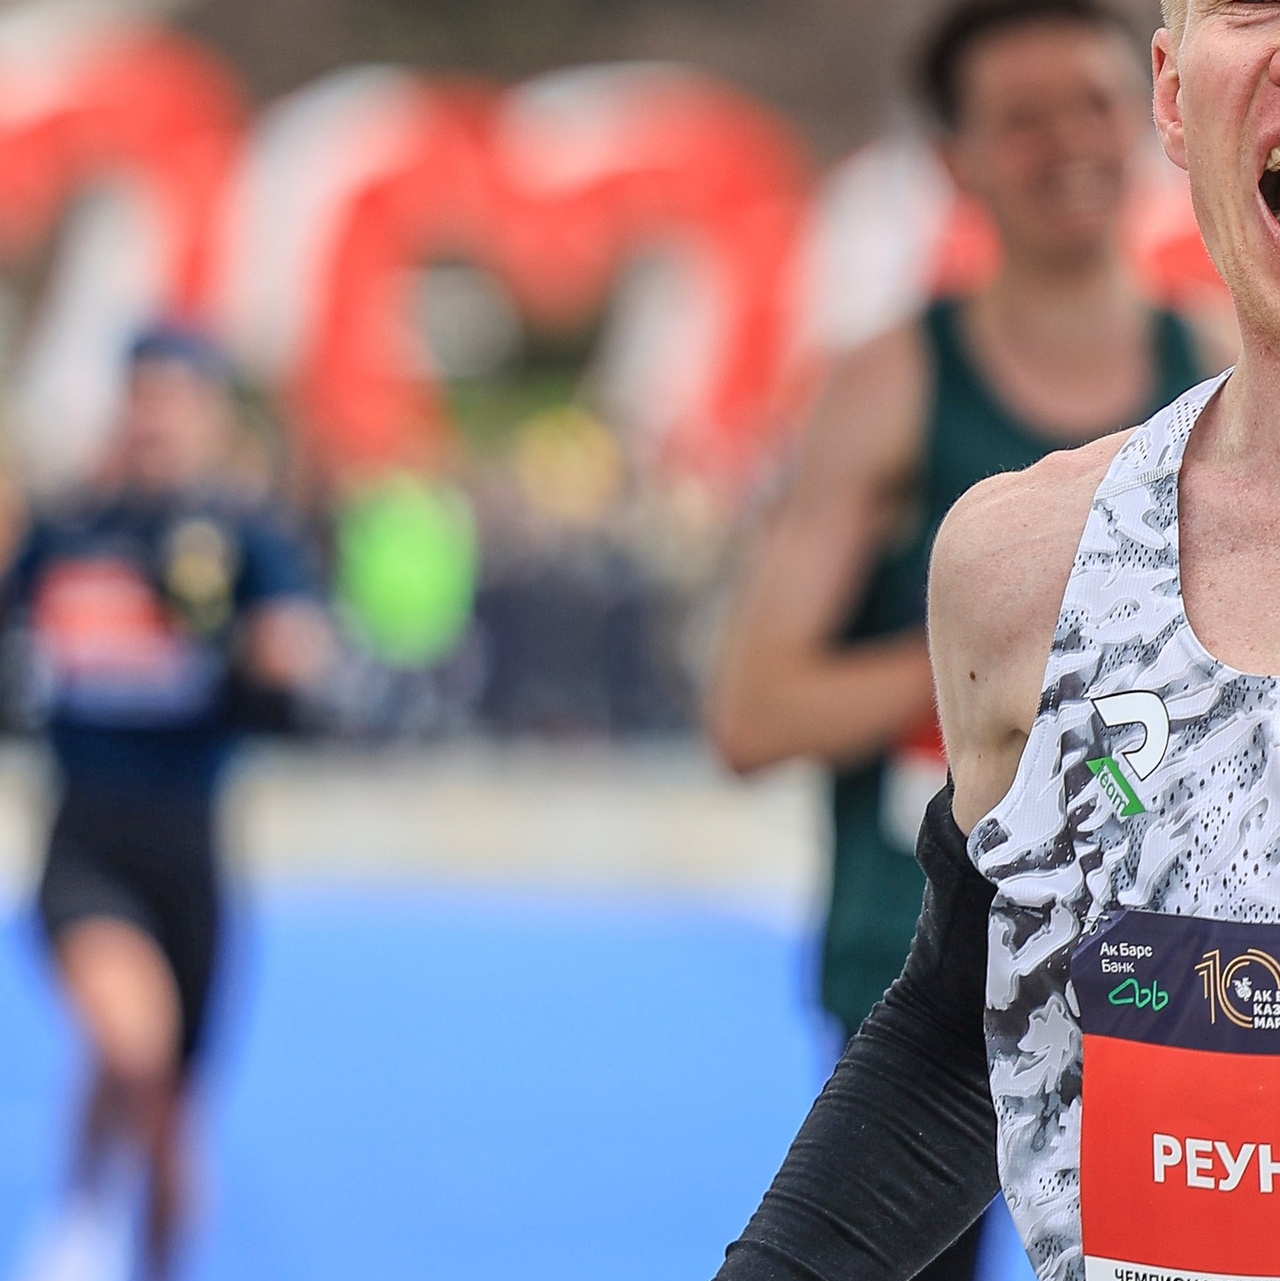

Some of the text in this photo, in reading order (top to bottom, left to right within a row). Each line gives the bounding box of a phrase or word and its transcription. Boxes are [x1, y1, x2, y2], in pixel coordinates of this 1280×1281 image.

[1100, 941, 1153, 960] Ак Барс
[1101, 959, 1135, 973] Банк
[1253, 989, 1273, 1002] АК
